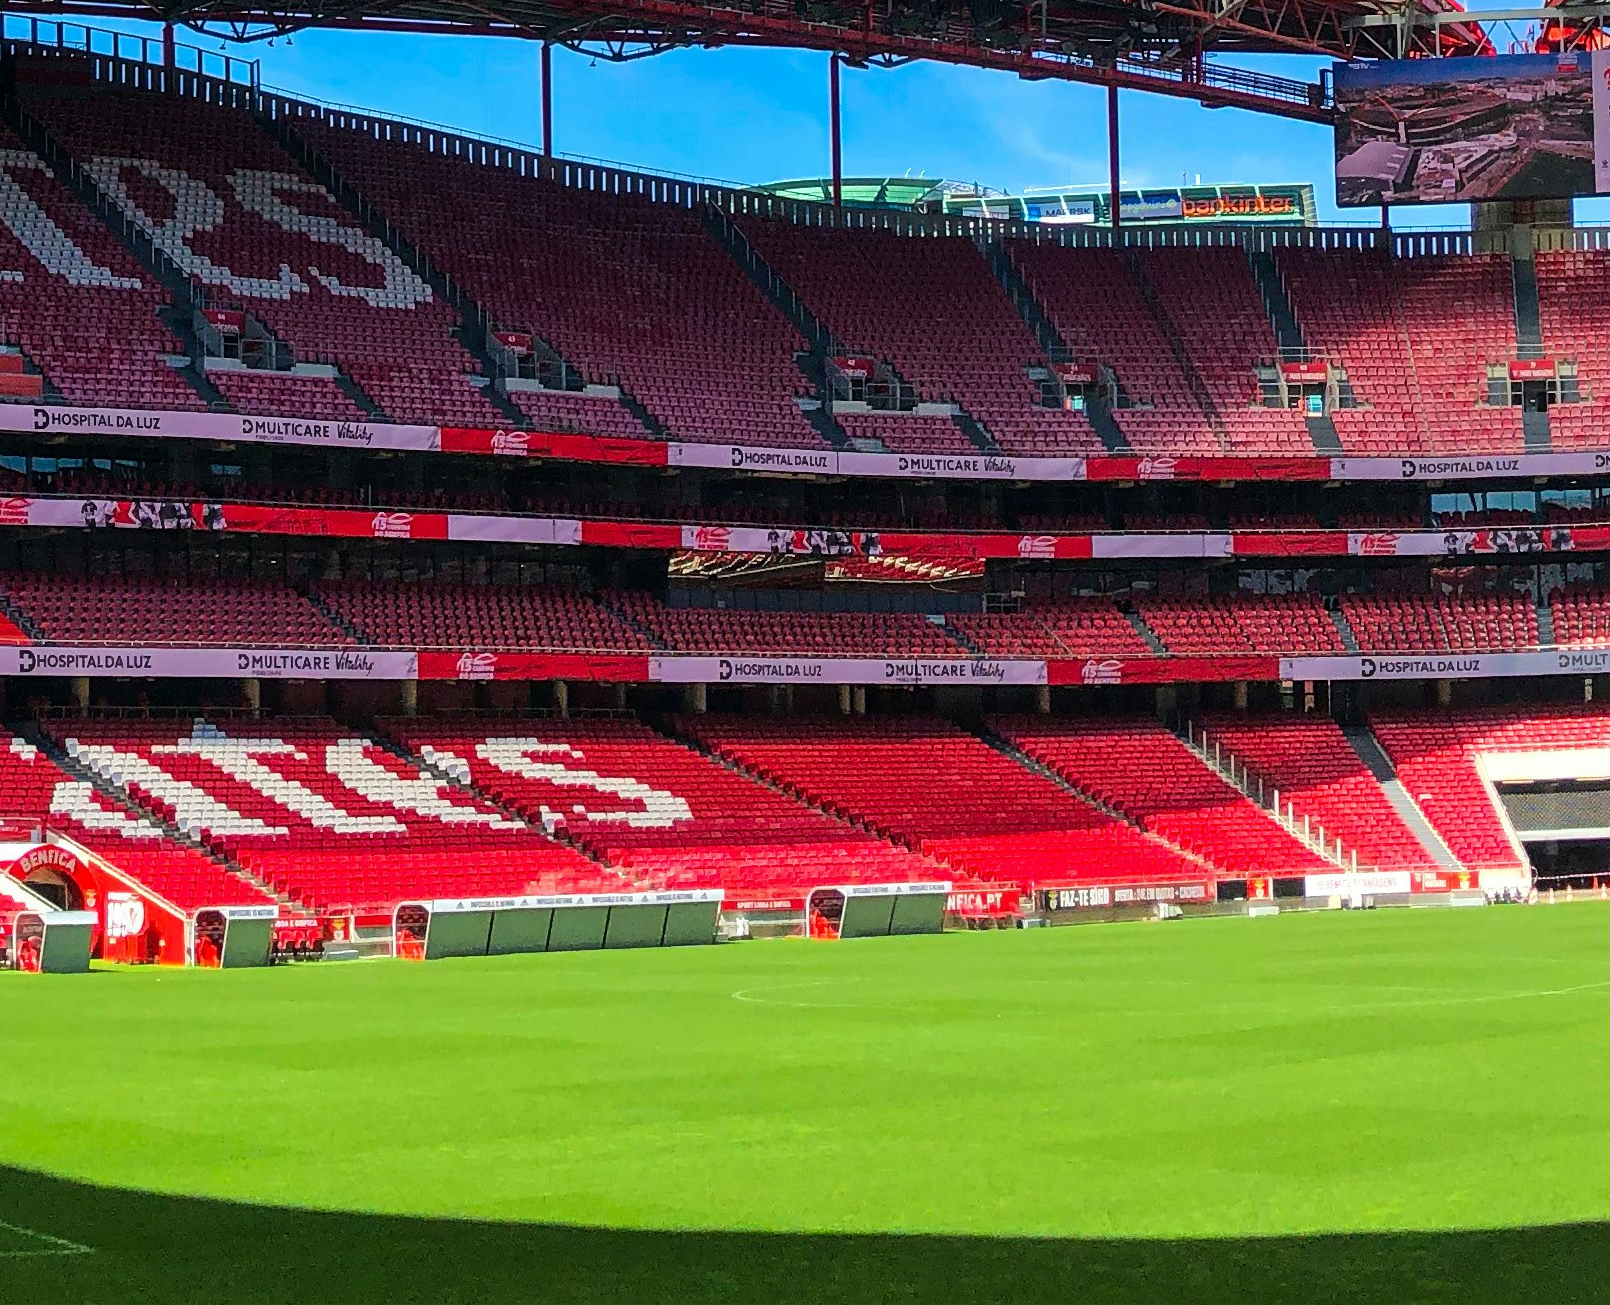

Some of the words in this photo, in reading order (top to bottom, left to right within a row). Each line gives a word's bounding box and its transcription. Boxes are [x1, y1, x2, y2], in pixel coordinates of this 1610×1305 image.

[1182, 194, 1294, 215] bankinter
[51, 412, 114, 429] HOSPITAL
[116, 415, 135, 429] DA
[137, 417, 160, 430] LUZ
[256, 421, 330, 438] MULTICARE
[336, 422, 374, 445] Vitality
[745, 452, 792, 466] HOSPITAL
[794, 455, 809, 466] DA
[809, 455, 827, 467] LUZ
[911, 459, 979, 472] MULTICARE
[984, 456, 1016, 477] Vitality
[1418, 462, 1475, 473] HOSPITAL
[1477, 461, 1492, 472] DA
[1496, 460, 1519, 471] LUZ
[37, 655, 103, 669] HOSPITAL
[105, 656, 124, 669] DA
[127, 655, 152, 669] LUZ
[252, 656, 330, 670] MULTICARE
[335, 652, 374, 676] Vitality
[735, 664, 783, 676] HOSPITAL
[785, 665, 801, 677] DA
[803, 666, 821, 677] LUZ
[896, 664, 966, 678] MULTICARE
[971, 661, 1005, 681] Vitality
[1380, 660, 1435, 673] HOSPITAL
[1437, 660, 1455, 672] DA
[1457, 659, 1480, 671] LUZ
[20, 849, 76, 873] BENFICA
[943, 893, 1002, 911] NFICA.PT
